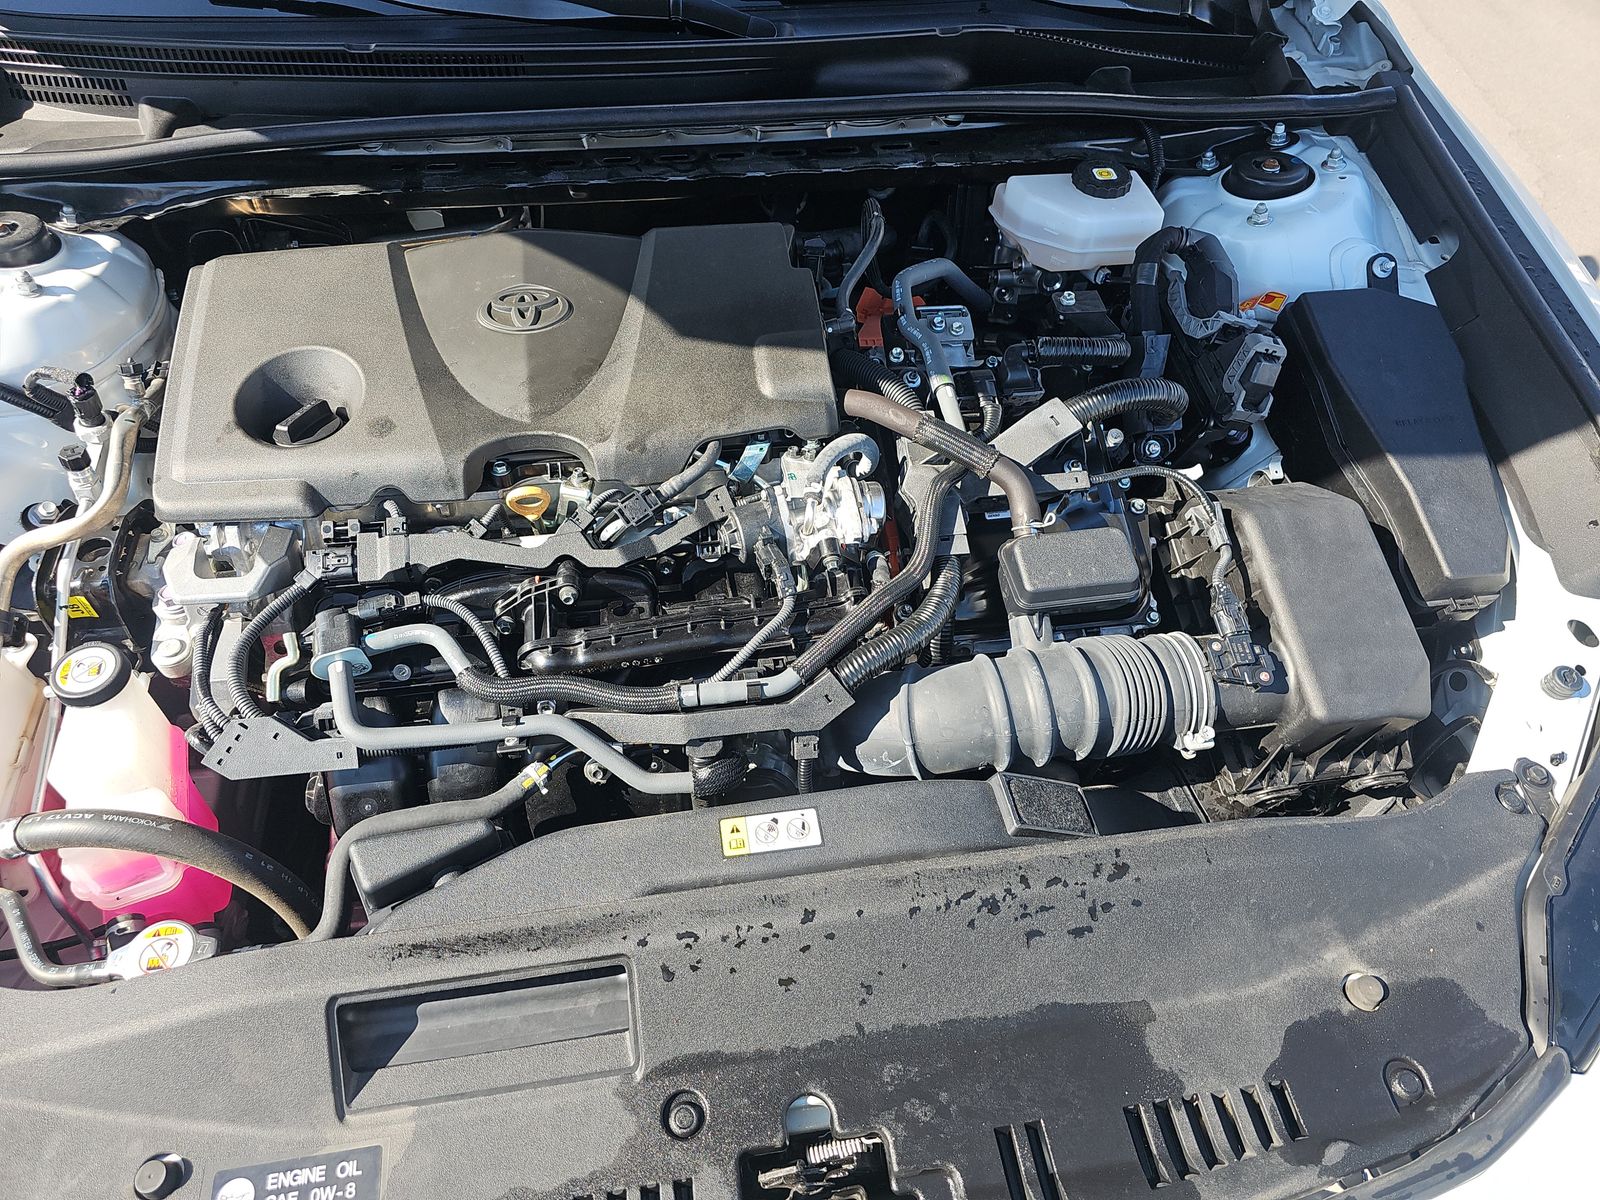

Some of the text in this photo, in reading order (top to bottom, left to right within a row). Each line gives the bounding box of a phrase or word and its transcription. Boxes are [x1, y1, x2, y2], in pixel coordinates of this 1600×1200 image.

[102, 813, 157, 827] YOKOHAMA
[20, 930, 33, 951] WATER
[266, 1159, 363, 1190] ENGINE OIL
[310, 1181, 356, 1200] 0W-8
